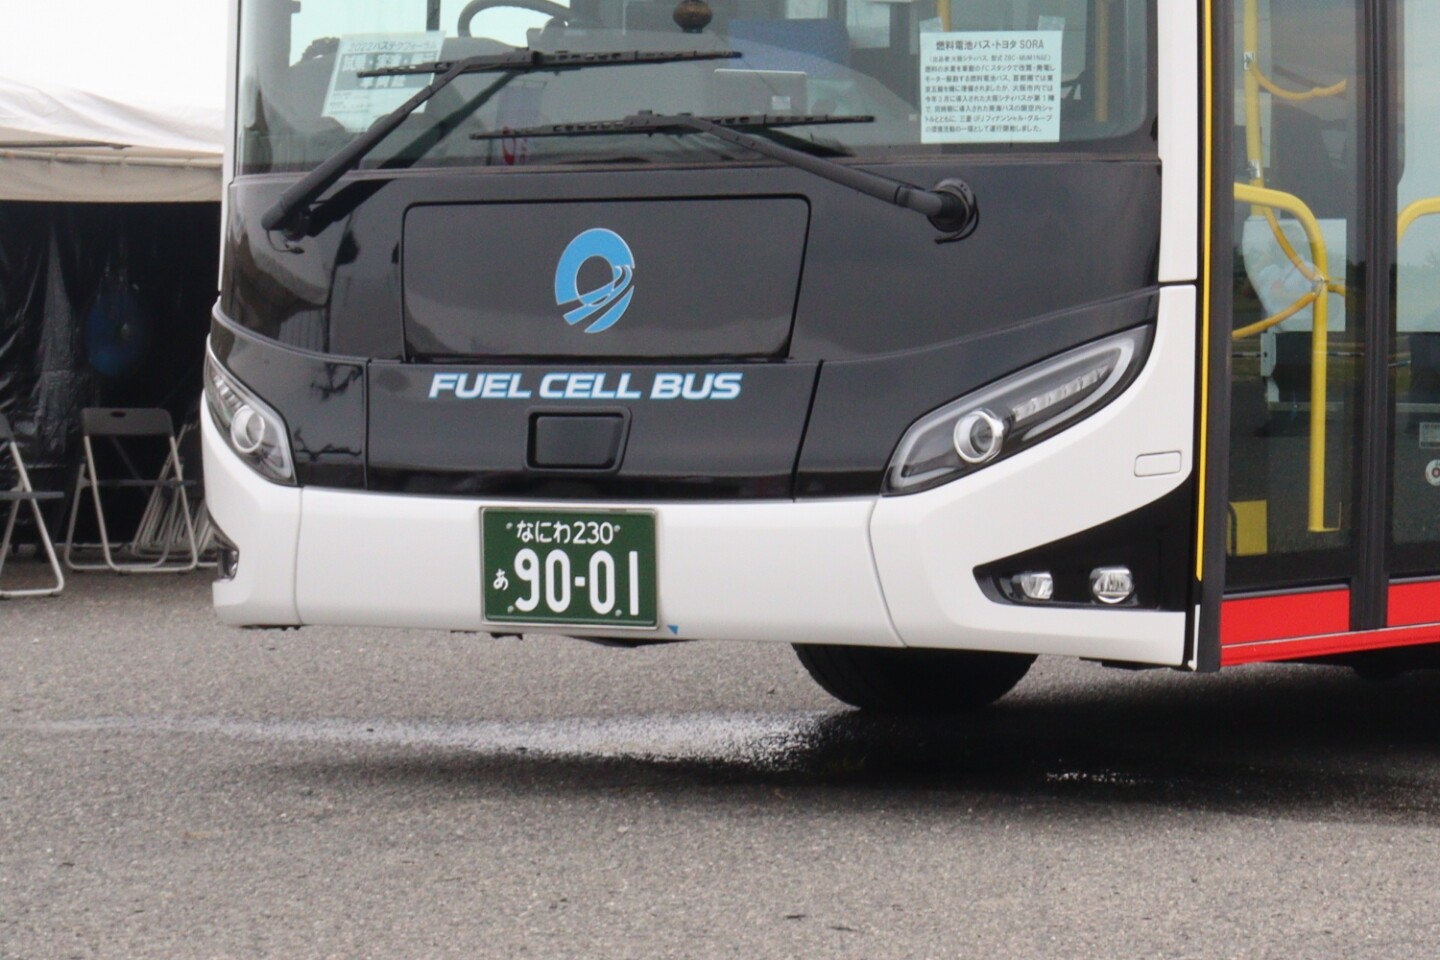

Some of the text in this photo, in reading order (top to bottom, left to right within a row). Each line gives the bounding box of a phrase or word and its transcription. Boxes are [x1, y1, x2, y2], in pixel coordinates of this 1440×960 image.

[1020, 40, 1045, 50] SORA
[428, 372, 744, 400] FUEL CELL BUS
[493, 548, 640, 616] あ 90-01
